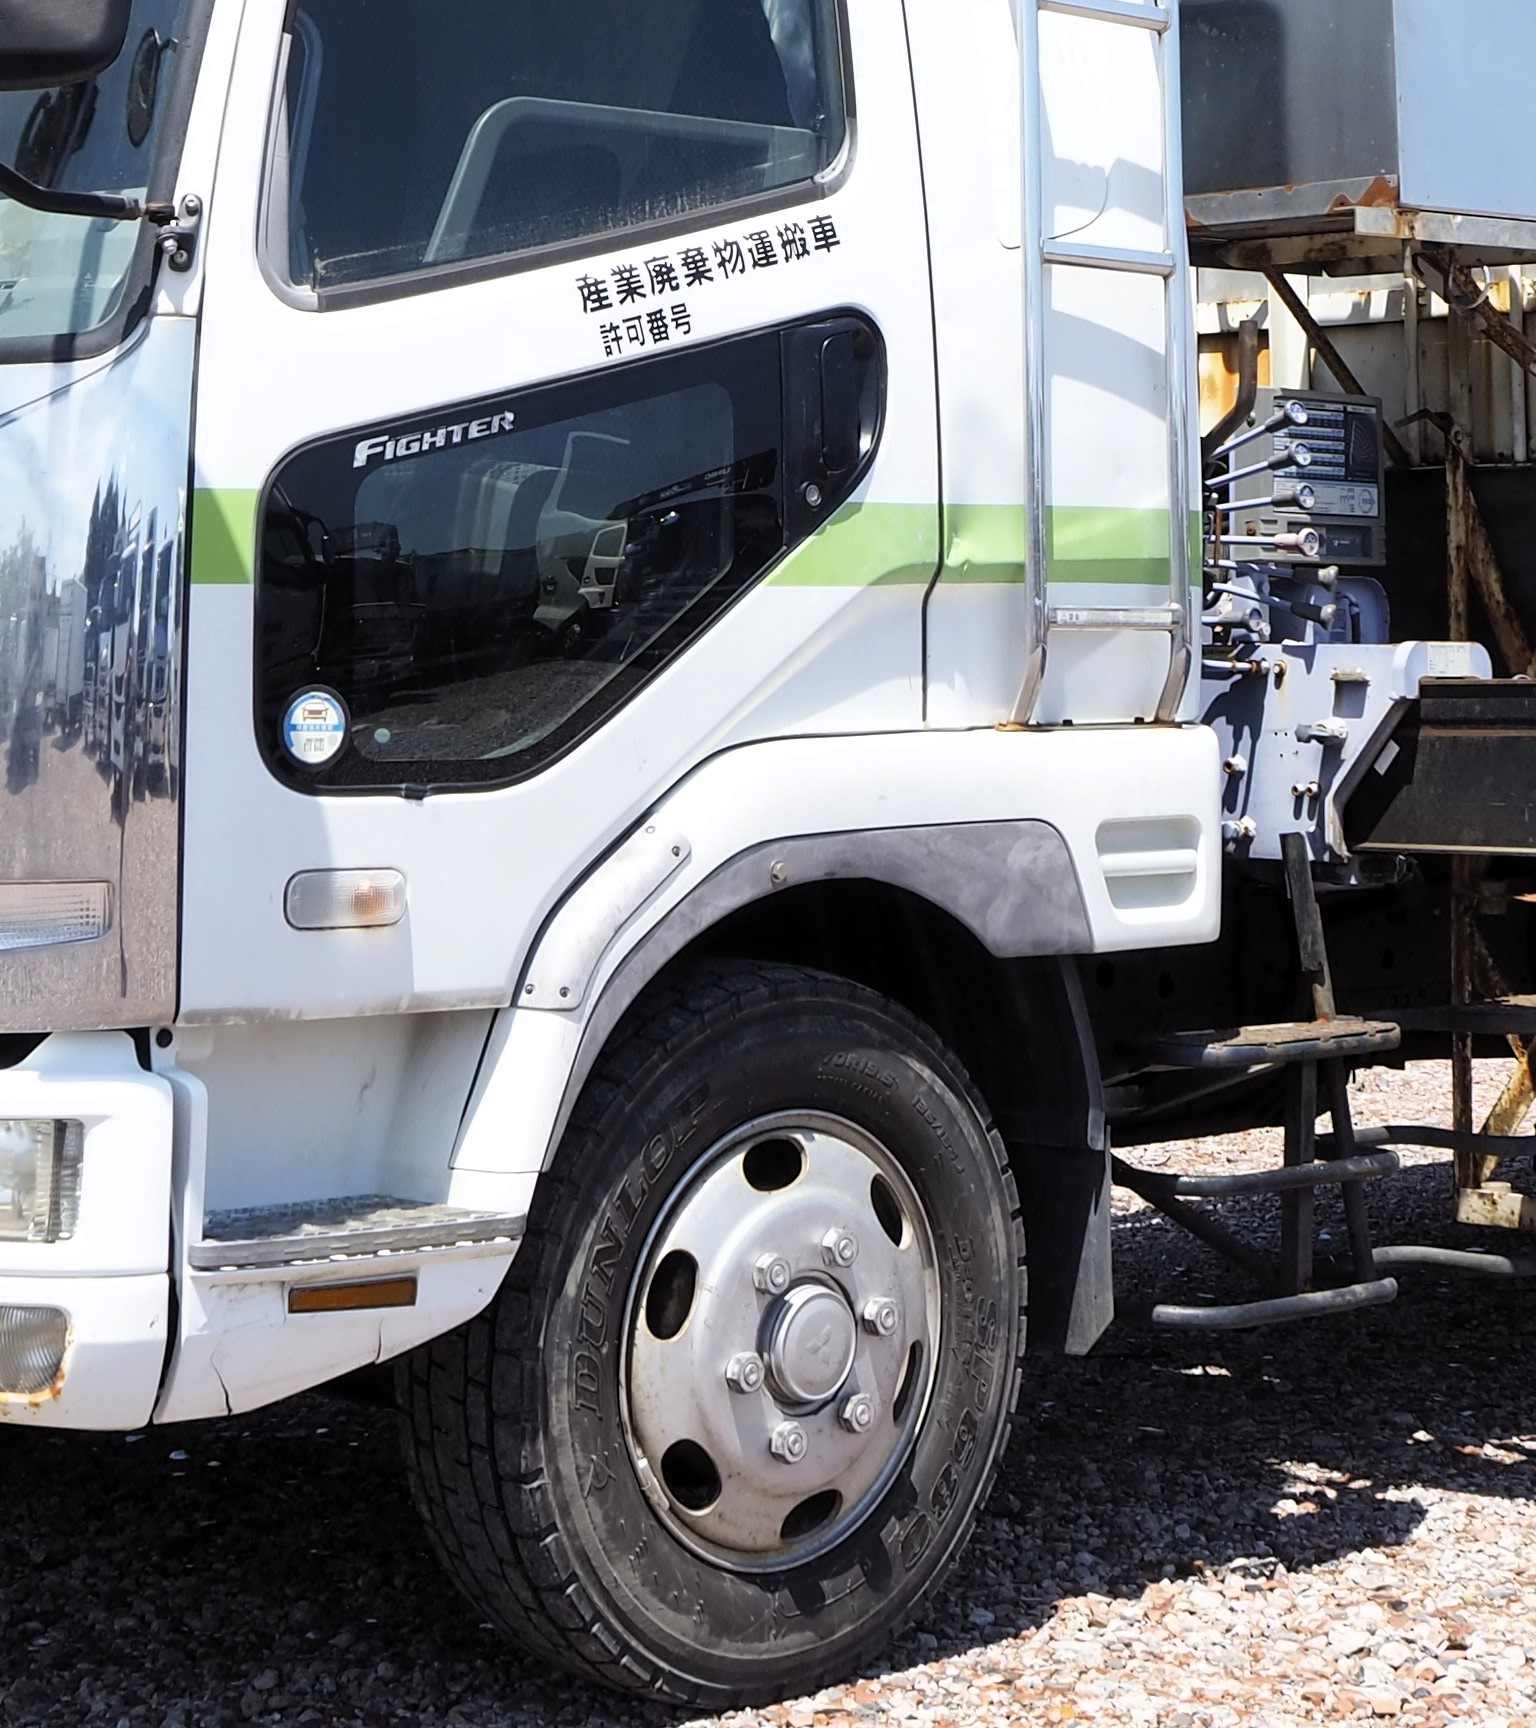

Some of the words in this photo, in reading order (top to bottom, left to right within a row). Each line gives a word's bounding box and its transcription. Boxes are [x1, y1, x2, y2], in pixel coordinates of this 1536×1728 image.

[575, 214, 841, 314] 産業廃棄物運搬車
[599, 303, 692, 357] 許可番号
[352, 410, 515, 469] FIGHTER
[573, 1081, 710, 1422] DUNLOP
